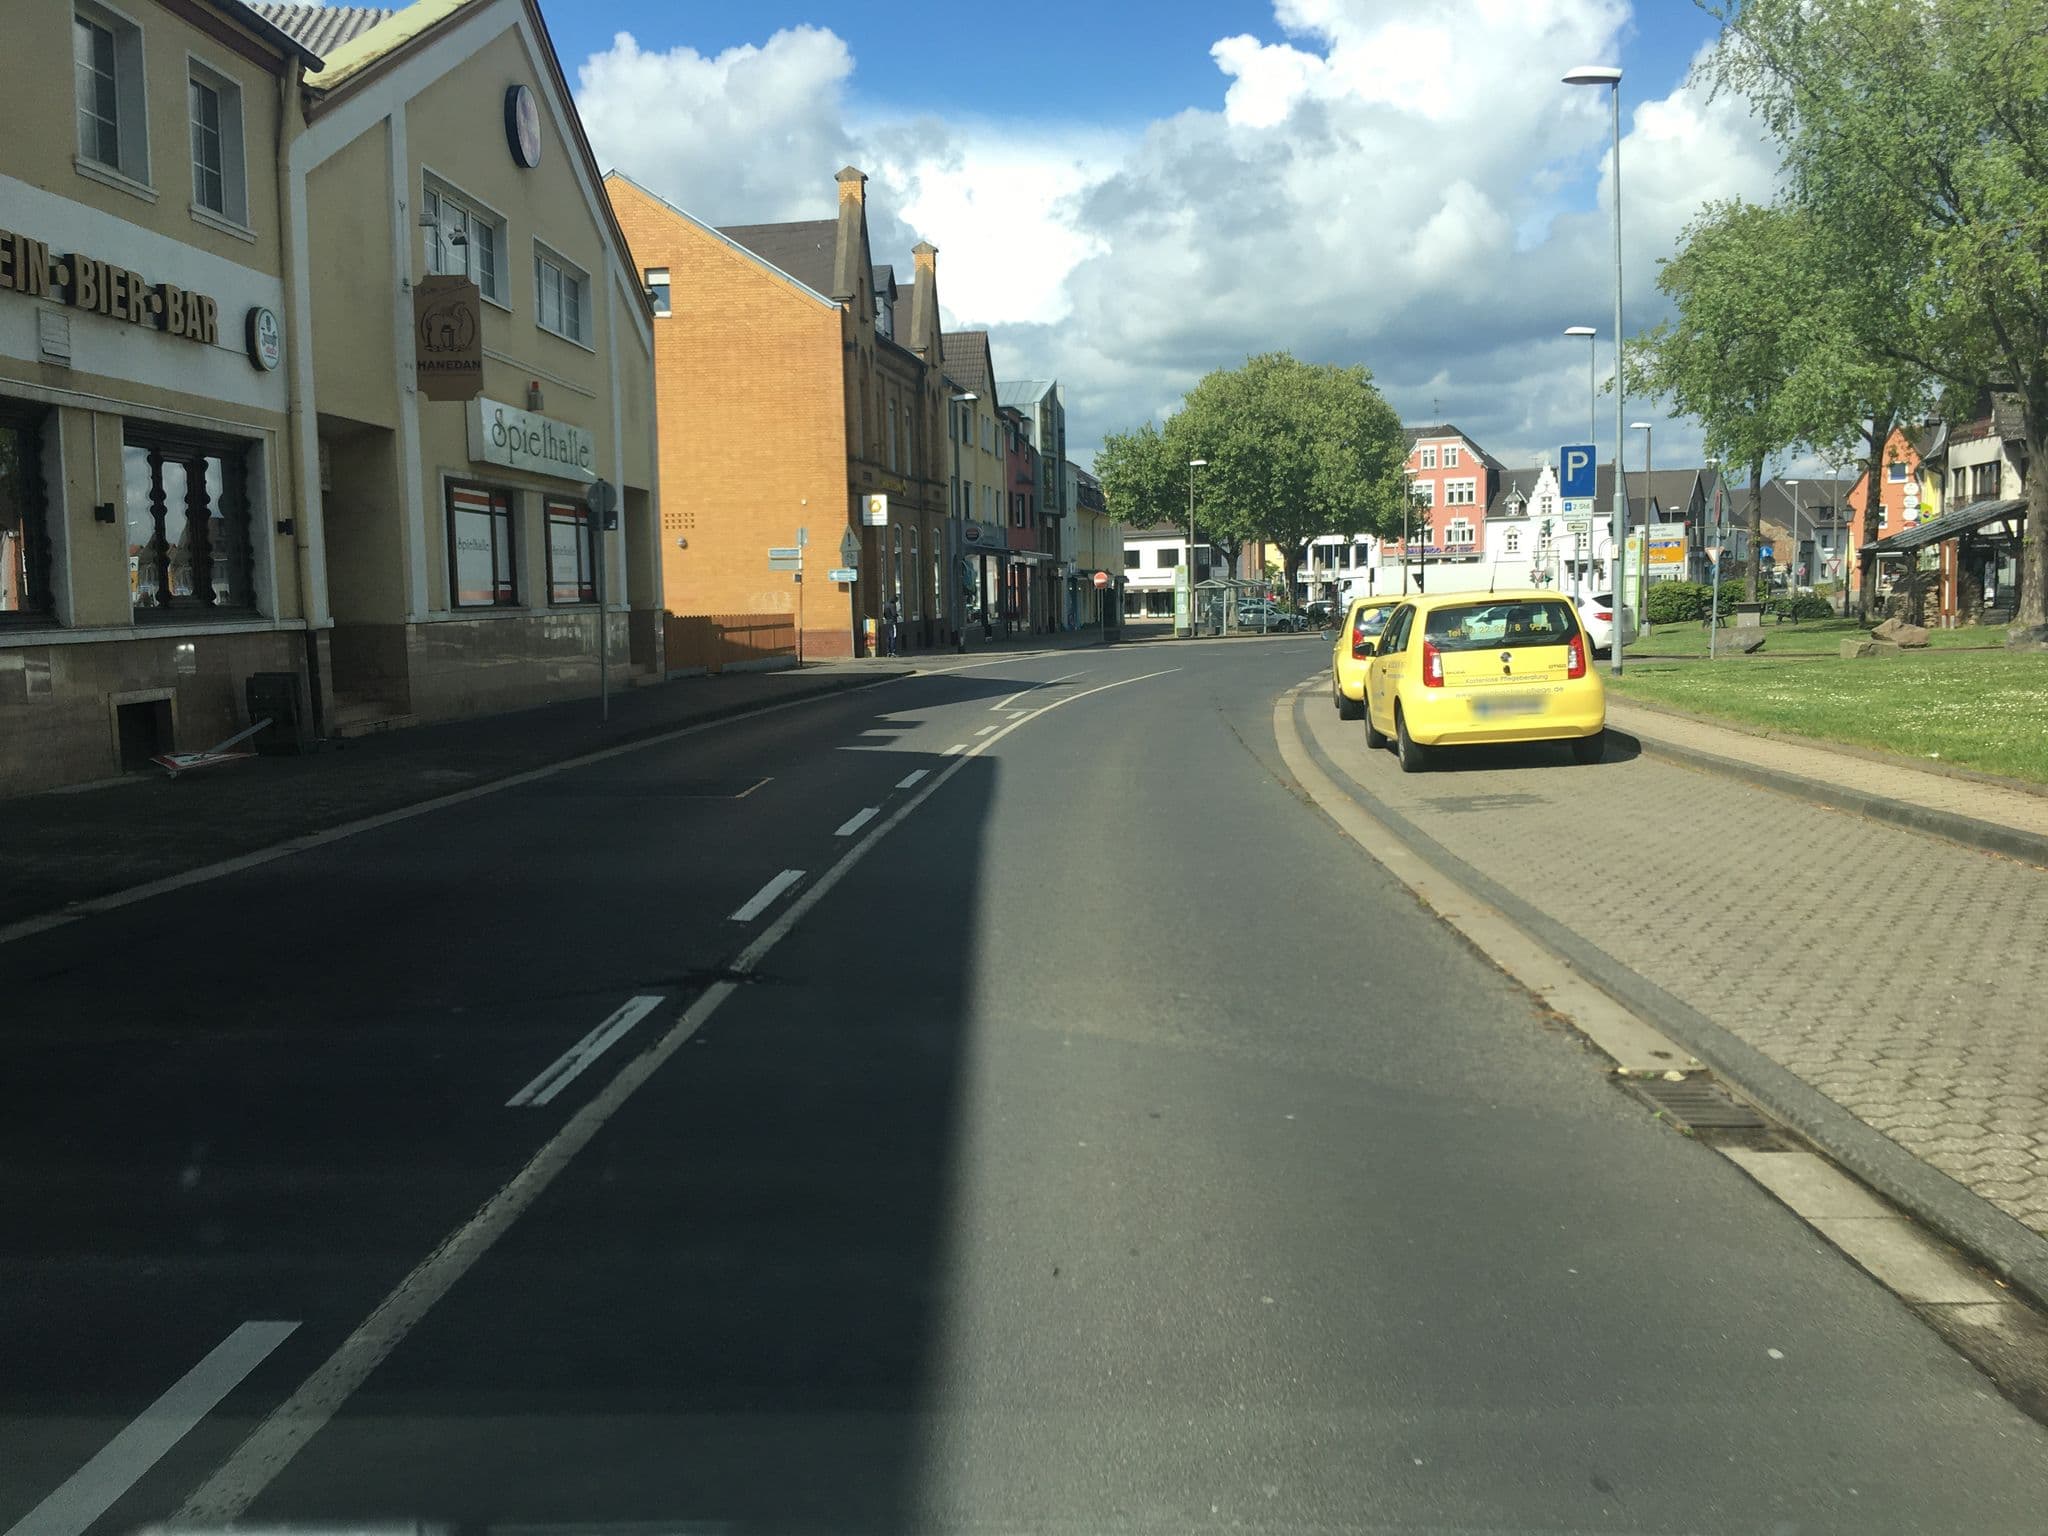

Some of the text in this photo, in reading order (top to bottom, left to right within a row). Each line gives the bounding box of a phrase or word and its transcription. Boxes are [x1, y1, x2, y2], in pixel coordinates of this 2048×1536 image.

[72, 253, 147, 326] BIER
[165, 284, 219, 344] BAR
[417, 360, 481, 371] HANEDAN
[492, 408, 590, 468] Spielhalle
[1567, 451, 1589, 482] P
